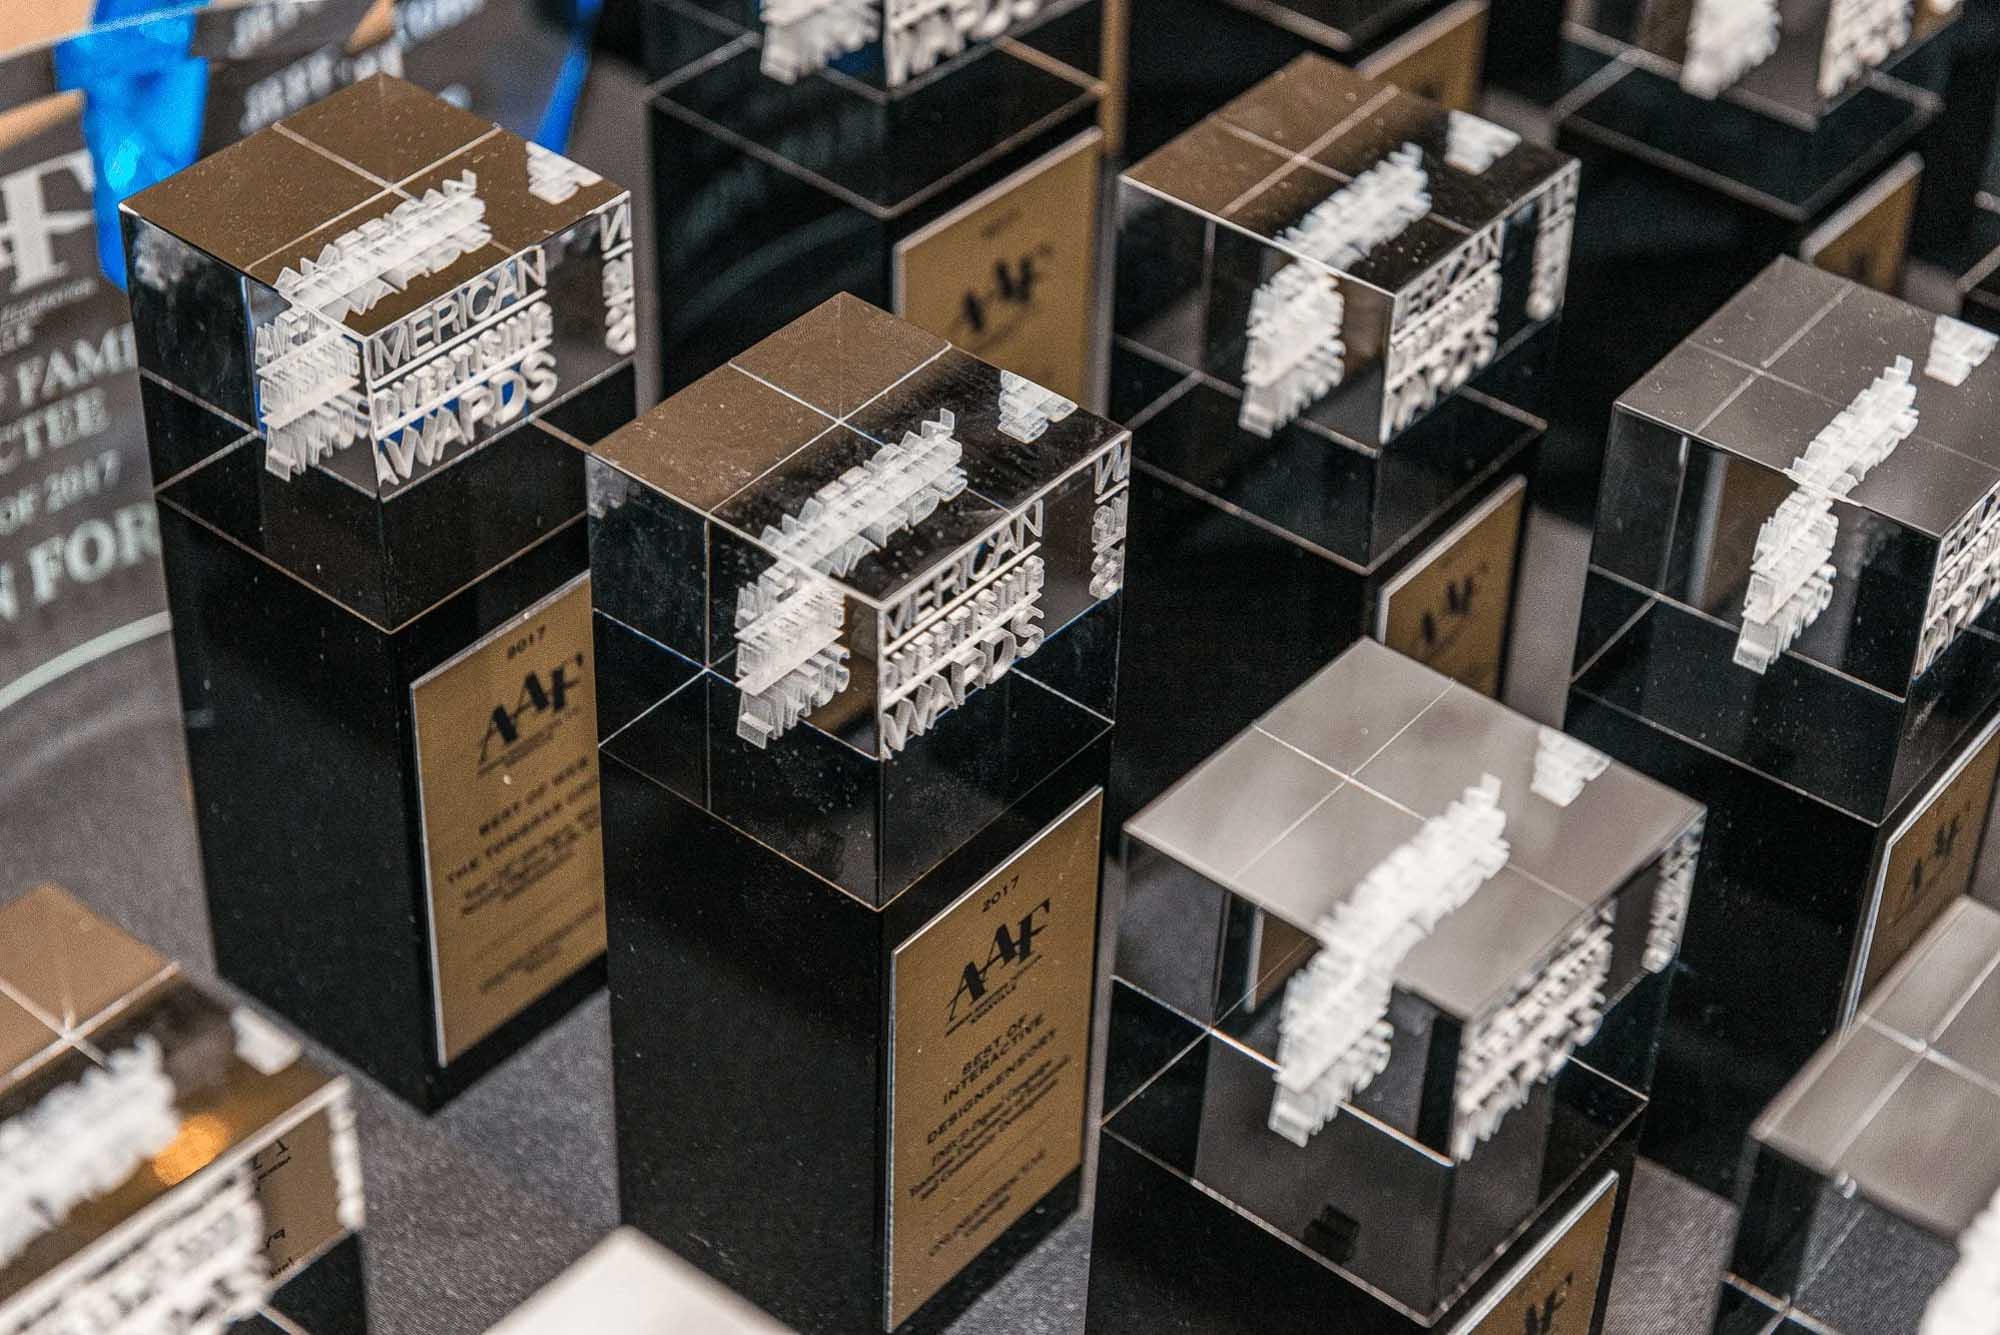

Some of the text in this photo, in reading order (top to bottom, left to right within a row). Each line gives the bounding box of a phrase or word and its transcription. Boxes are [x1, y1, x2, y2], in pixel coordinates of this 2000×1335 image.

[29, 502, 162, 604] FOR
[477, 651, 584, 766] AAF
[981, 873, 1020, 914] 2017
[945, 897, 1050, 1026] AAF
[962, 1033, 1003, 1075] BEST
